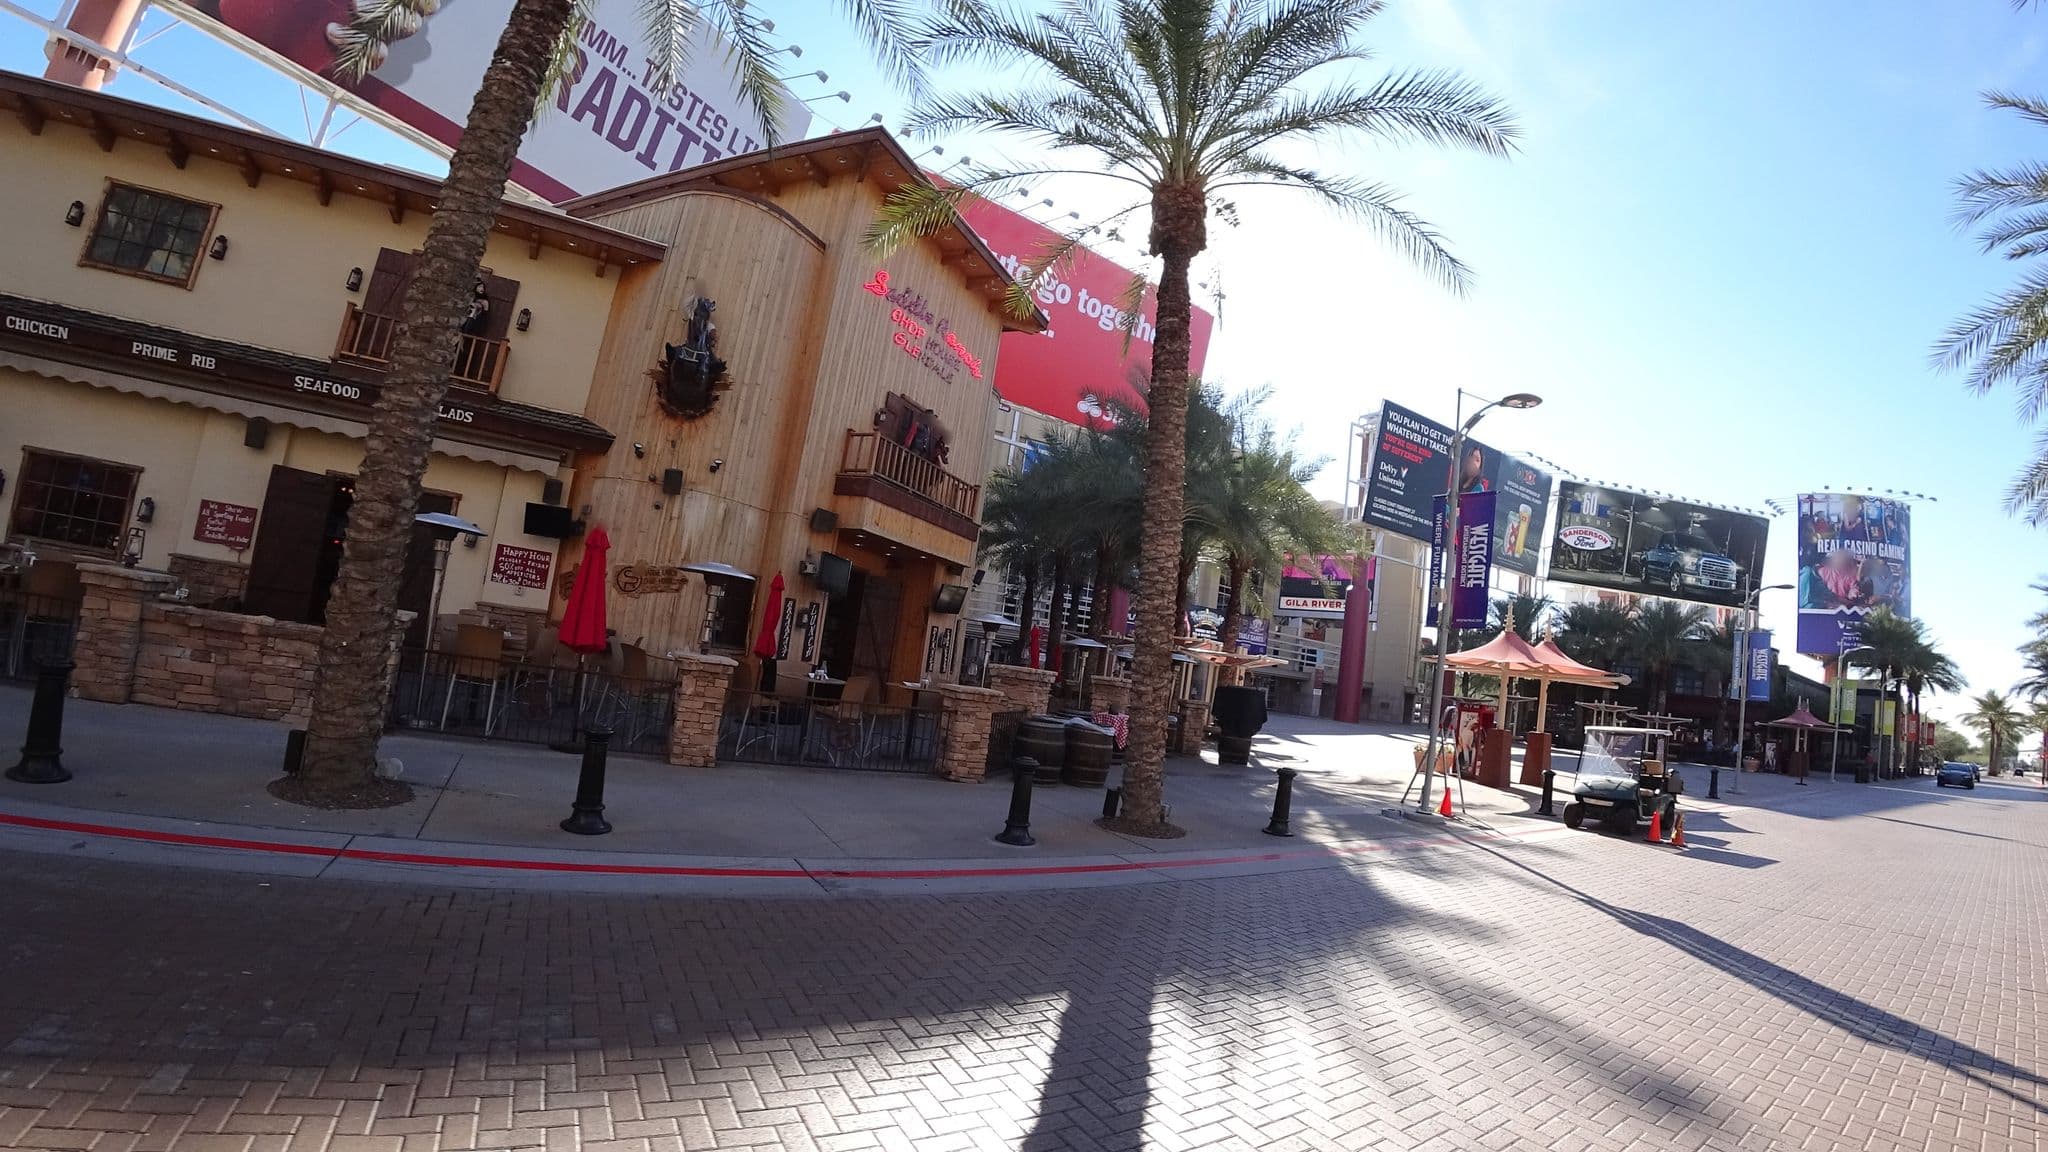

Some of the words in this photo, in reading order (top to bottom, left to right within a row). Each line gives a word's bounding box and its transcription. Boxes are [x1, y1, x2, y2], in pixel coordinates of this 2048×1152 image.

[727, 127, 759, 155] LI
[1037, 270, 1072, 304] go
[1077, 287, 1156, 345] togeh
[6, 316, 69, 339] CHICKEN
[132, 342, 178, 362] PRIME
[191, 353, 216, 369] RIB
[294, 375, 360, 400] SEAFOOD
[438, 405, 474, 423] LADS
[1387, 421, 1421, 444] WHATEVER
[1422, 436, 1428, 447] IT
[1389, 410, 1403, 423] YOU
[1403, 417, 1420, 431] PLAN
[1421, 424, 1429, 435] TO
[1430, 429, 1442, 441] GET
[1380, 461, 1397, 477] DeVry
[1378, 471, 1405, 490] University
[1583, 492, 1598, 516] 60
[1434, 512, 1442, 544] WHERE
[1563, 529, 1608, 544] SANDERSON
[1574, 536, 1597, 548] Ford
[1817, 539, 1841, 553] REAL
[1844, 540, 1877, 556] CASINO
[503, 547, 528, 558] HAPPY
[529, 551, 550, 561] HOUR
[1433, 546, 1441, 564] FUN
[1467, 523, 1489, 588] WESTGATE
[499, 563, 514, 571] 50%
[1286, 599, 1308, 607] GILA
[1312, 600, 1342, 608] RIVER
